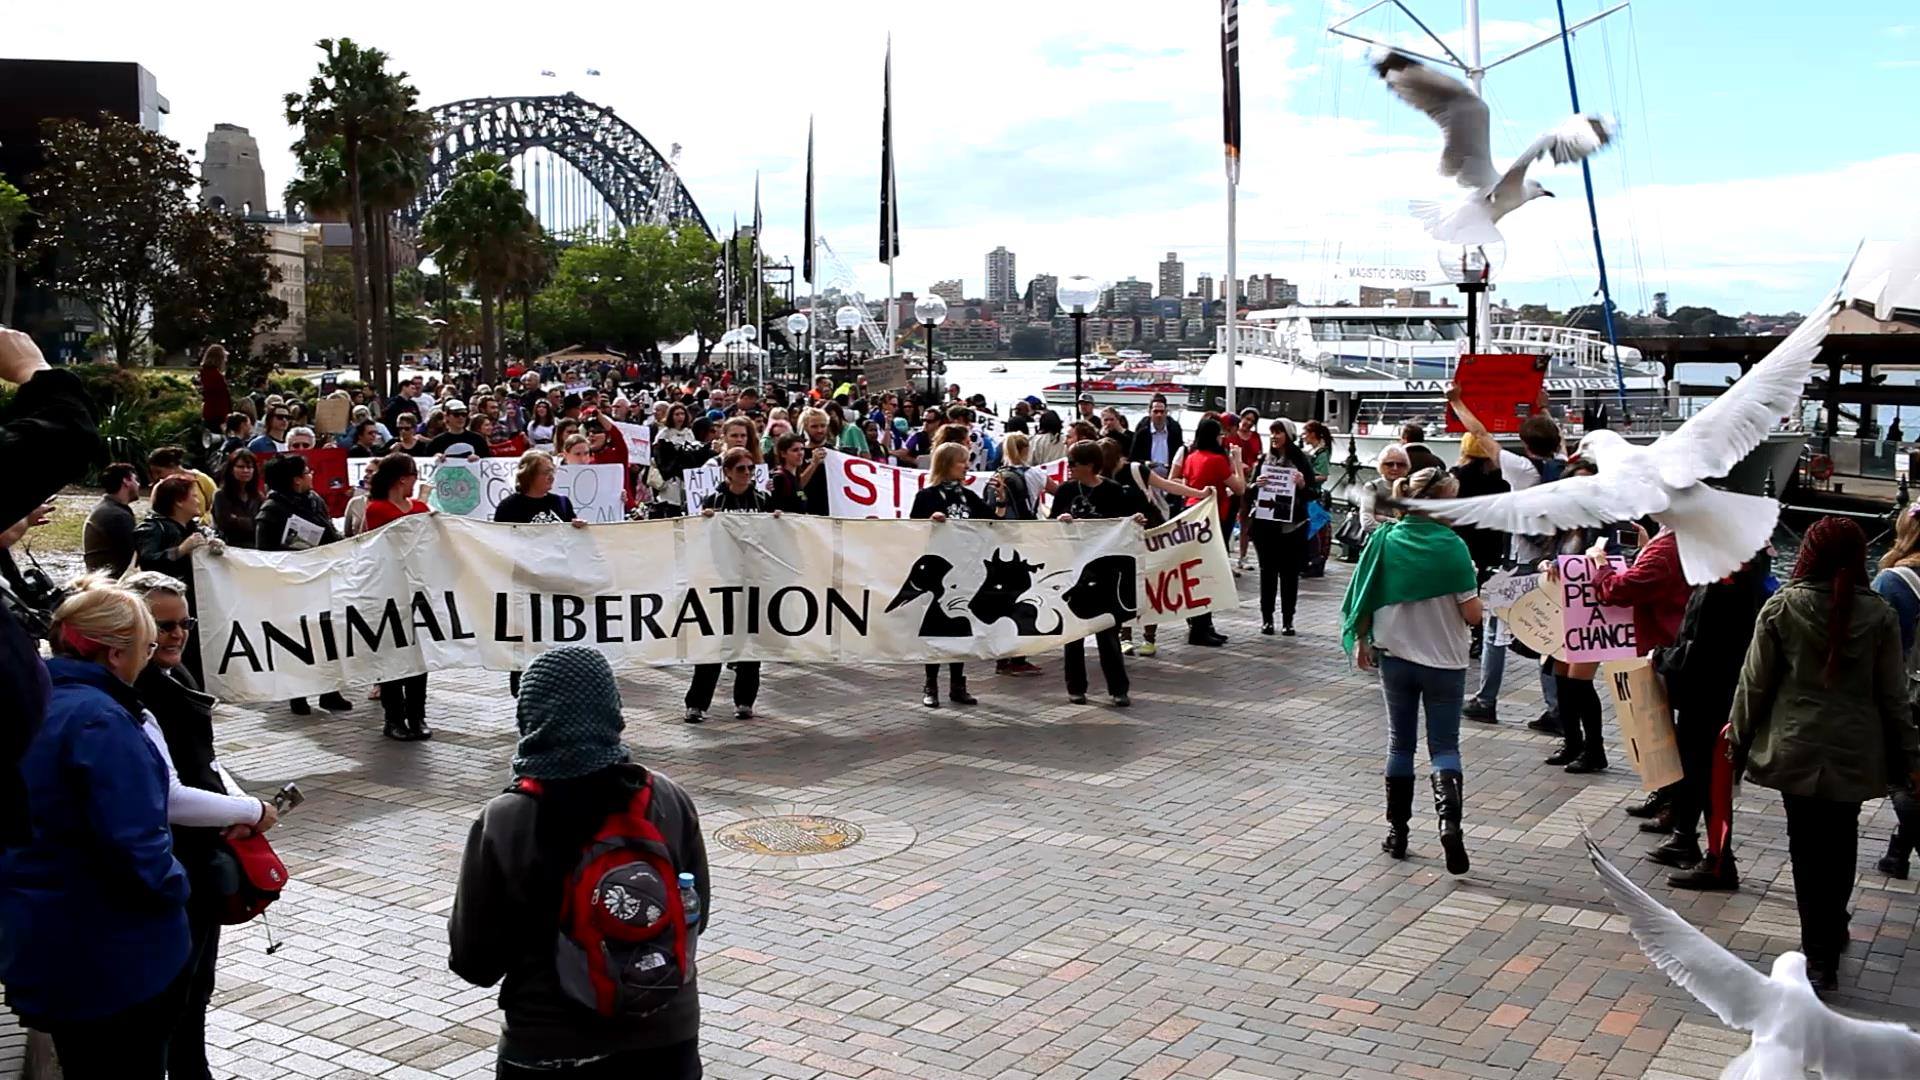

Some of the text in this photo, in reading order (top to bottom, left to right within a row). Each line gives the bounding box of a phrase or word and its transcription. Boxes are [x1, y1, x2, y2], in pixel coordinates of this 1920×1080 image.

[1389, 268, 1427, 281] CRUISES
[1588, 607, 1606, 625] A
[218, 586, 870, 675] ANIMAL LIBERATION
[1566, 624, 1637, 651] CHANCE
